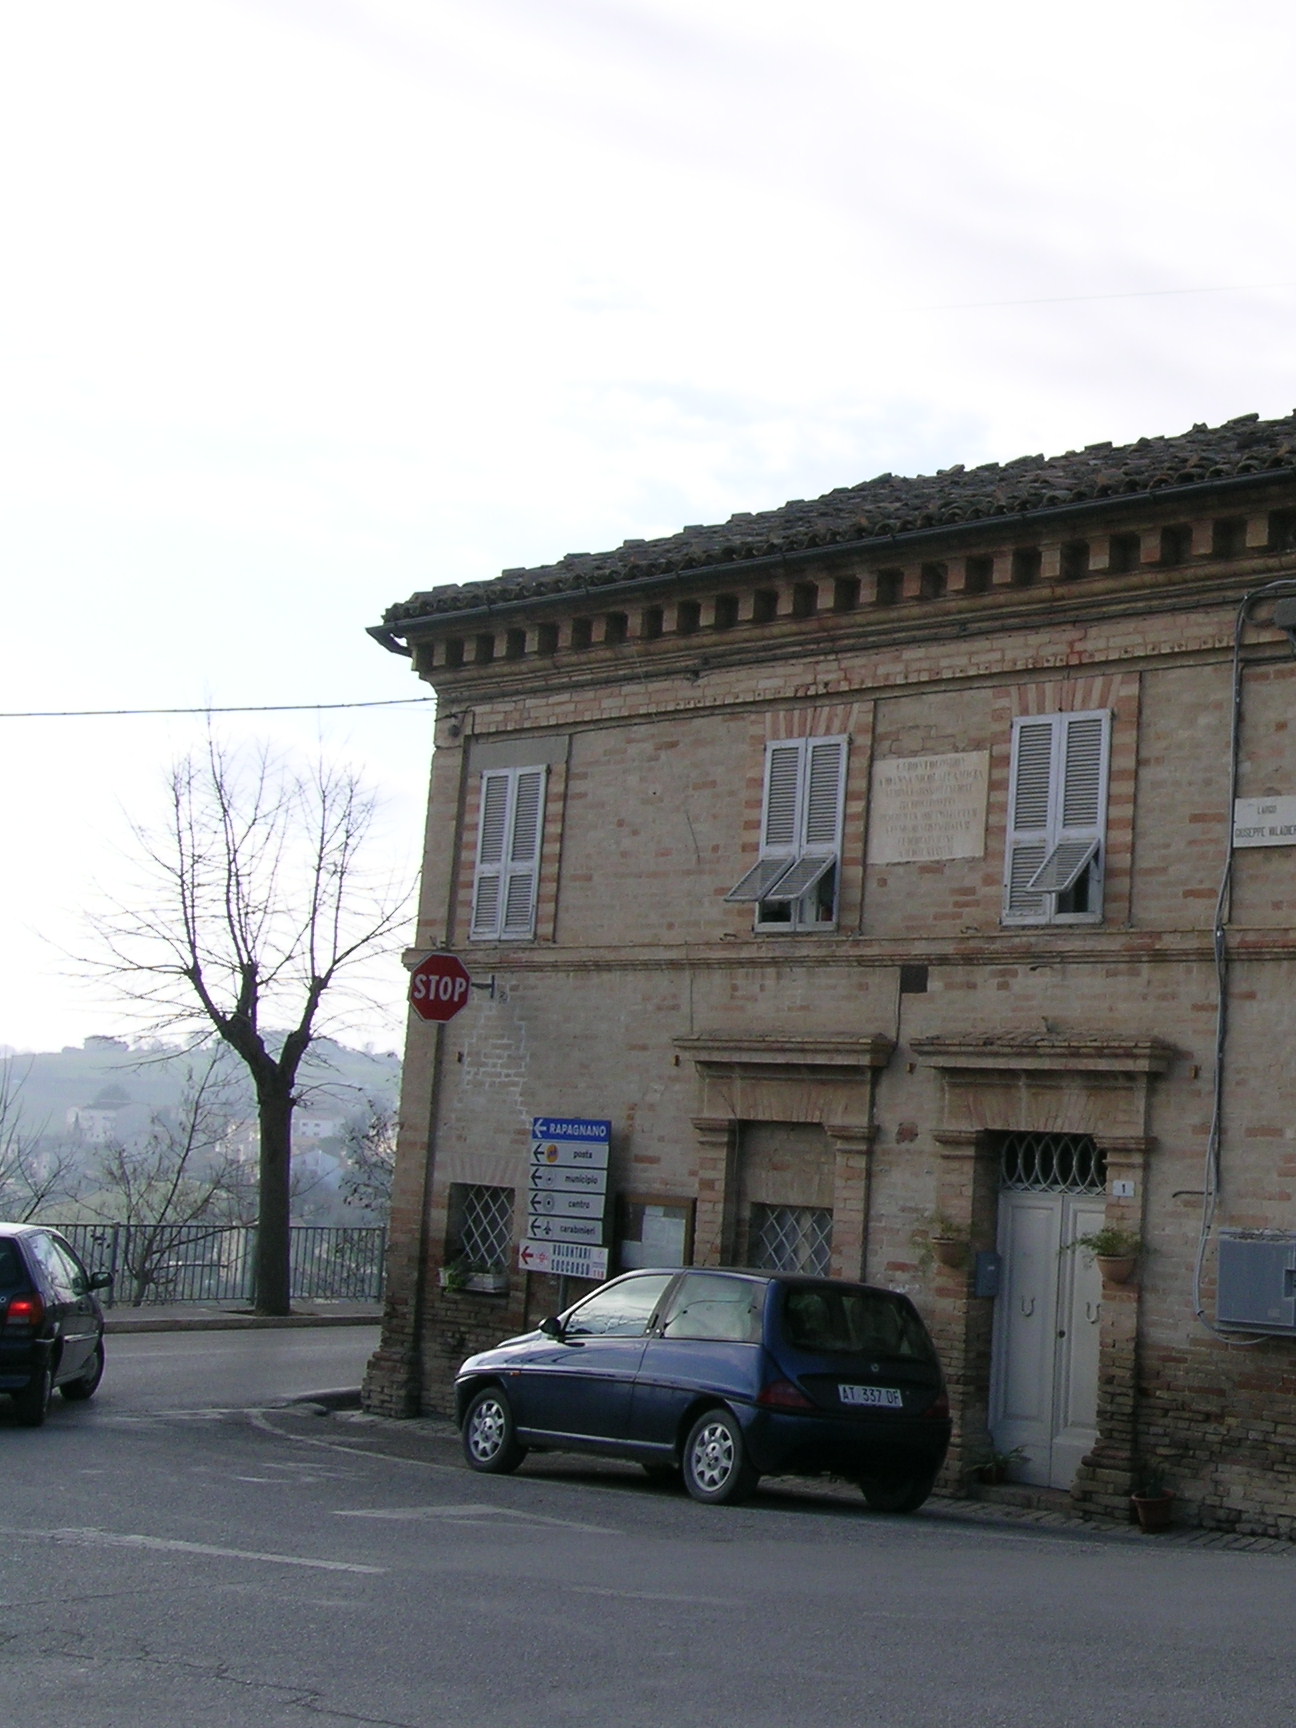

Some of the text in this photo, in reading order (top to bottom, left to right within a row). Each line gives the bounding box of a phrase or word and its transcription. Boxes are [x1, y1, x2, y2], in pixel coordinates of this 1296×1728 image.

[414, 973, 467, 1003] STOP
[549, 1123, 607, 1137] RAPAGNANO
[573, 1150, 593, 1159] posta
[564, 1174, 599, 1185] municipio
[1121, 1183, 1126, 1194] 1
[568, 1200, 590, 1209] centro
[560, 1225, 597, 1236] carabinieri
[550, 1259, 591, 1277] SOCCORSO
[842, 1386, 856, 1401] AT
[861, 1387, 882, 1403] 337
